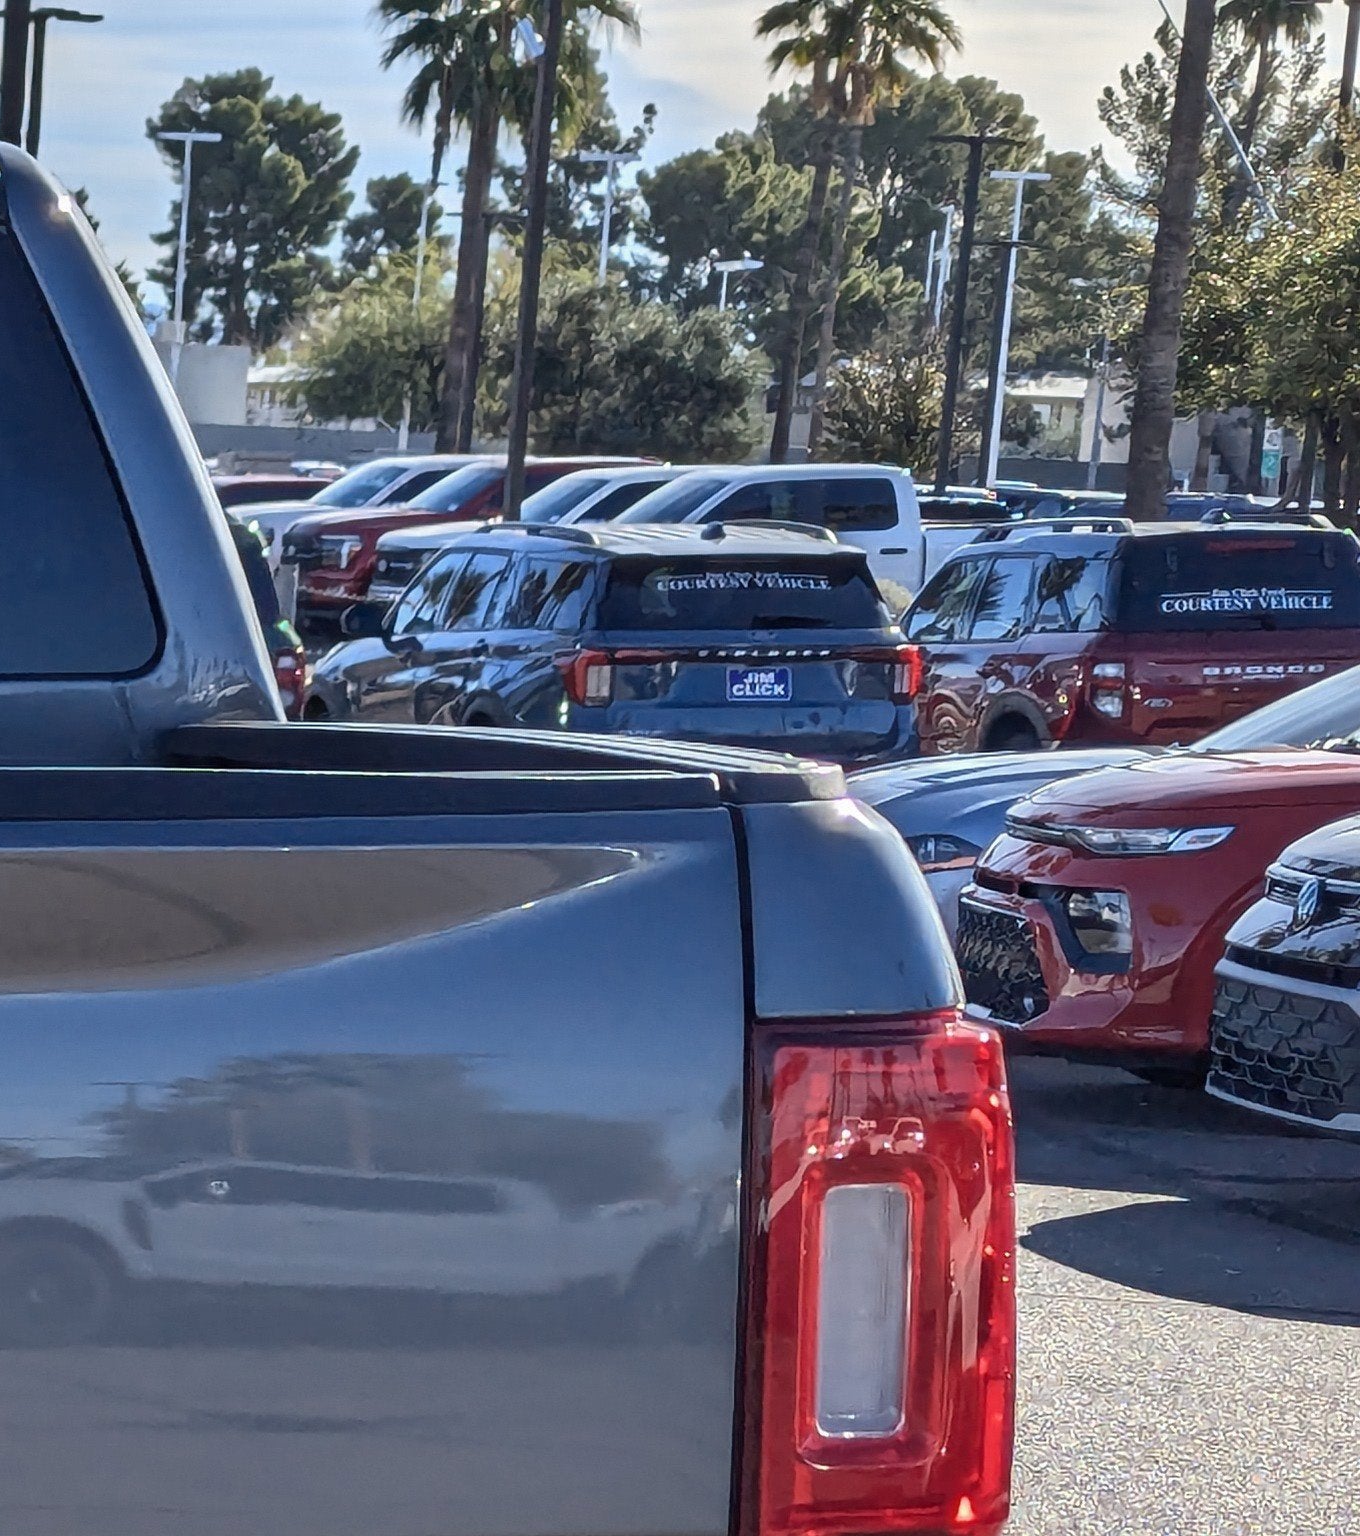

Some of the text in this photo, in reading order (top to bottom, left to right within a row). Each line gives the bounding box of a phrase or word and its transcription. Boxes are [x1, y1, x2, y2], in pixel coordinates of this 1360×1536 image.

[657, 577, 752, 591] COURTESY
[755, 576, 831, 590] VEHICLE
[1161, 596, 1333, 613] COURTESY VEHICLE
[743, 672, 775, 683] JIM
[732, 684, 785, 695] CLICK
